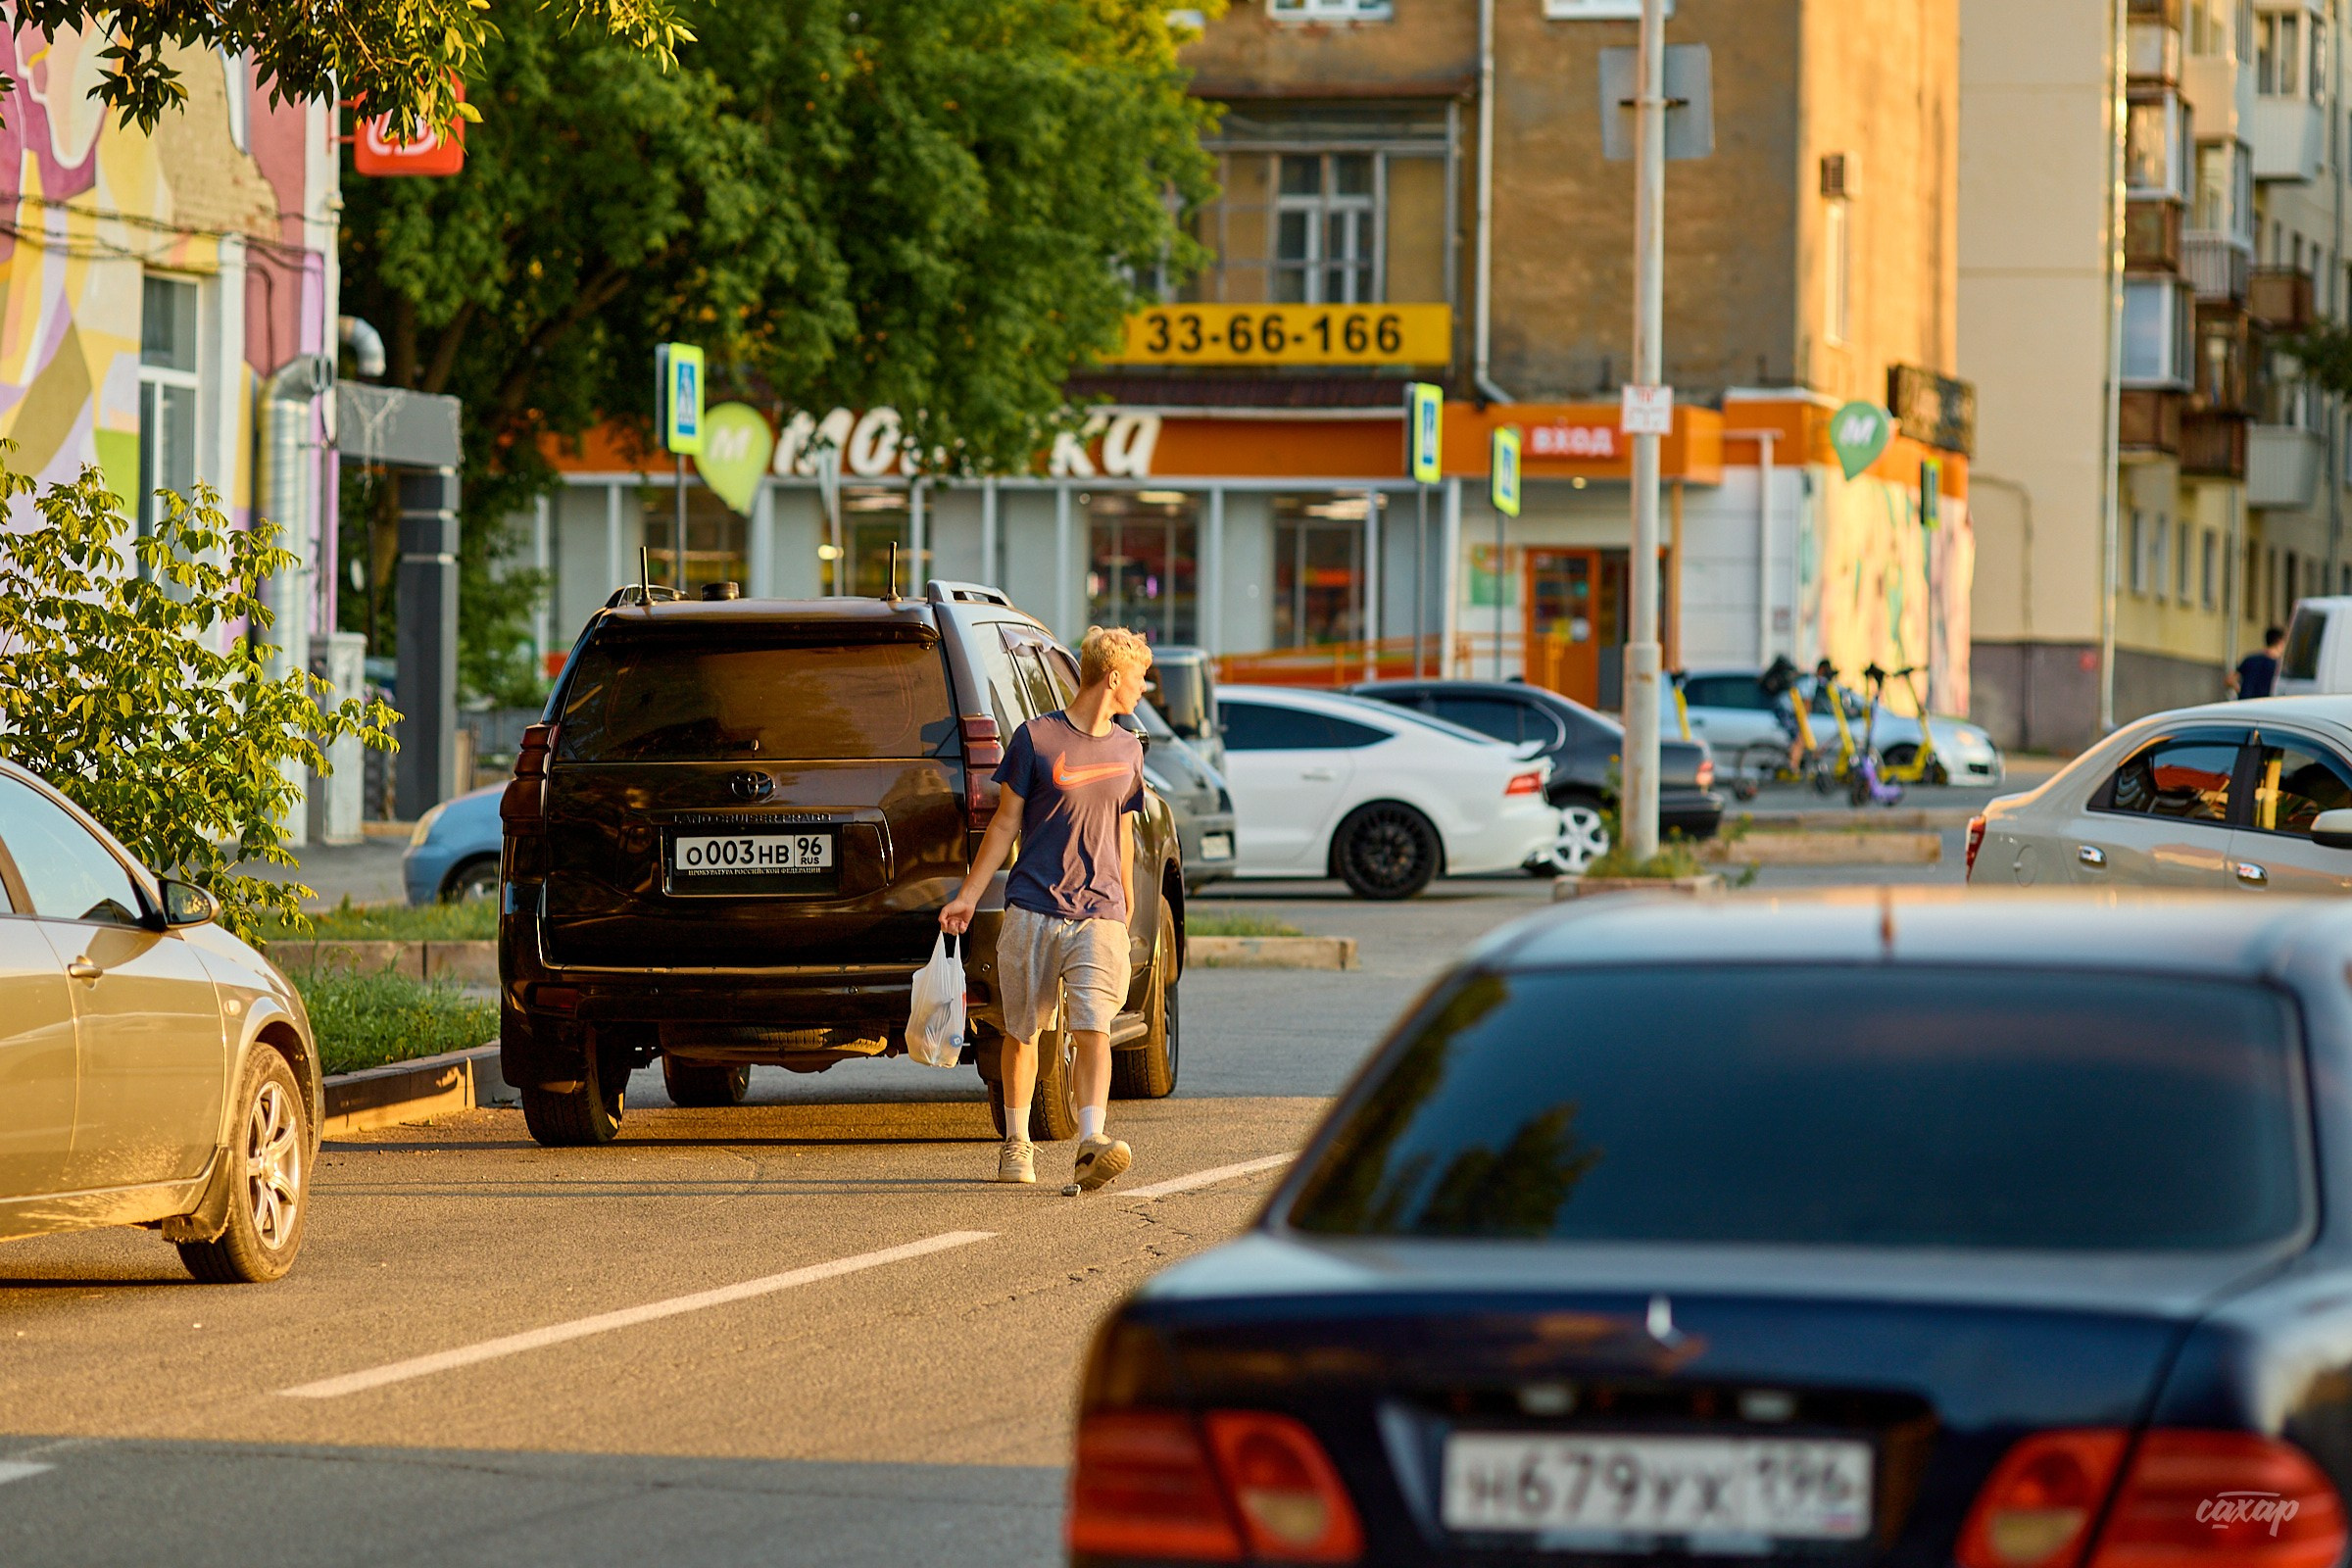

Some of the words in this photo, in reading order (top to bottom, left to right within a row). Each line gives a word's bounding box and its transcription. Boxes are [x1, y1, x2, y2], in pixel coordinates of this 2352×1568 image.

[1146, 314, 1402, 354] 33-66-166
[673, 814, 711, 824] LAND
[797, 836, 823, 857] 96
[801, 857, 820, 865] RUS
